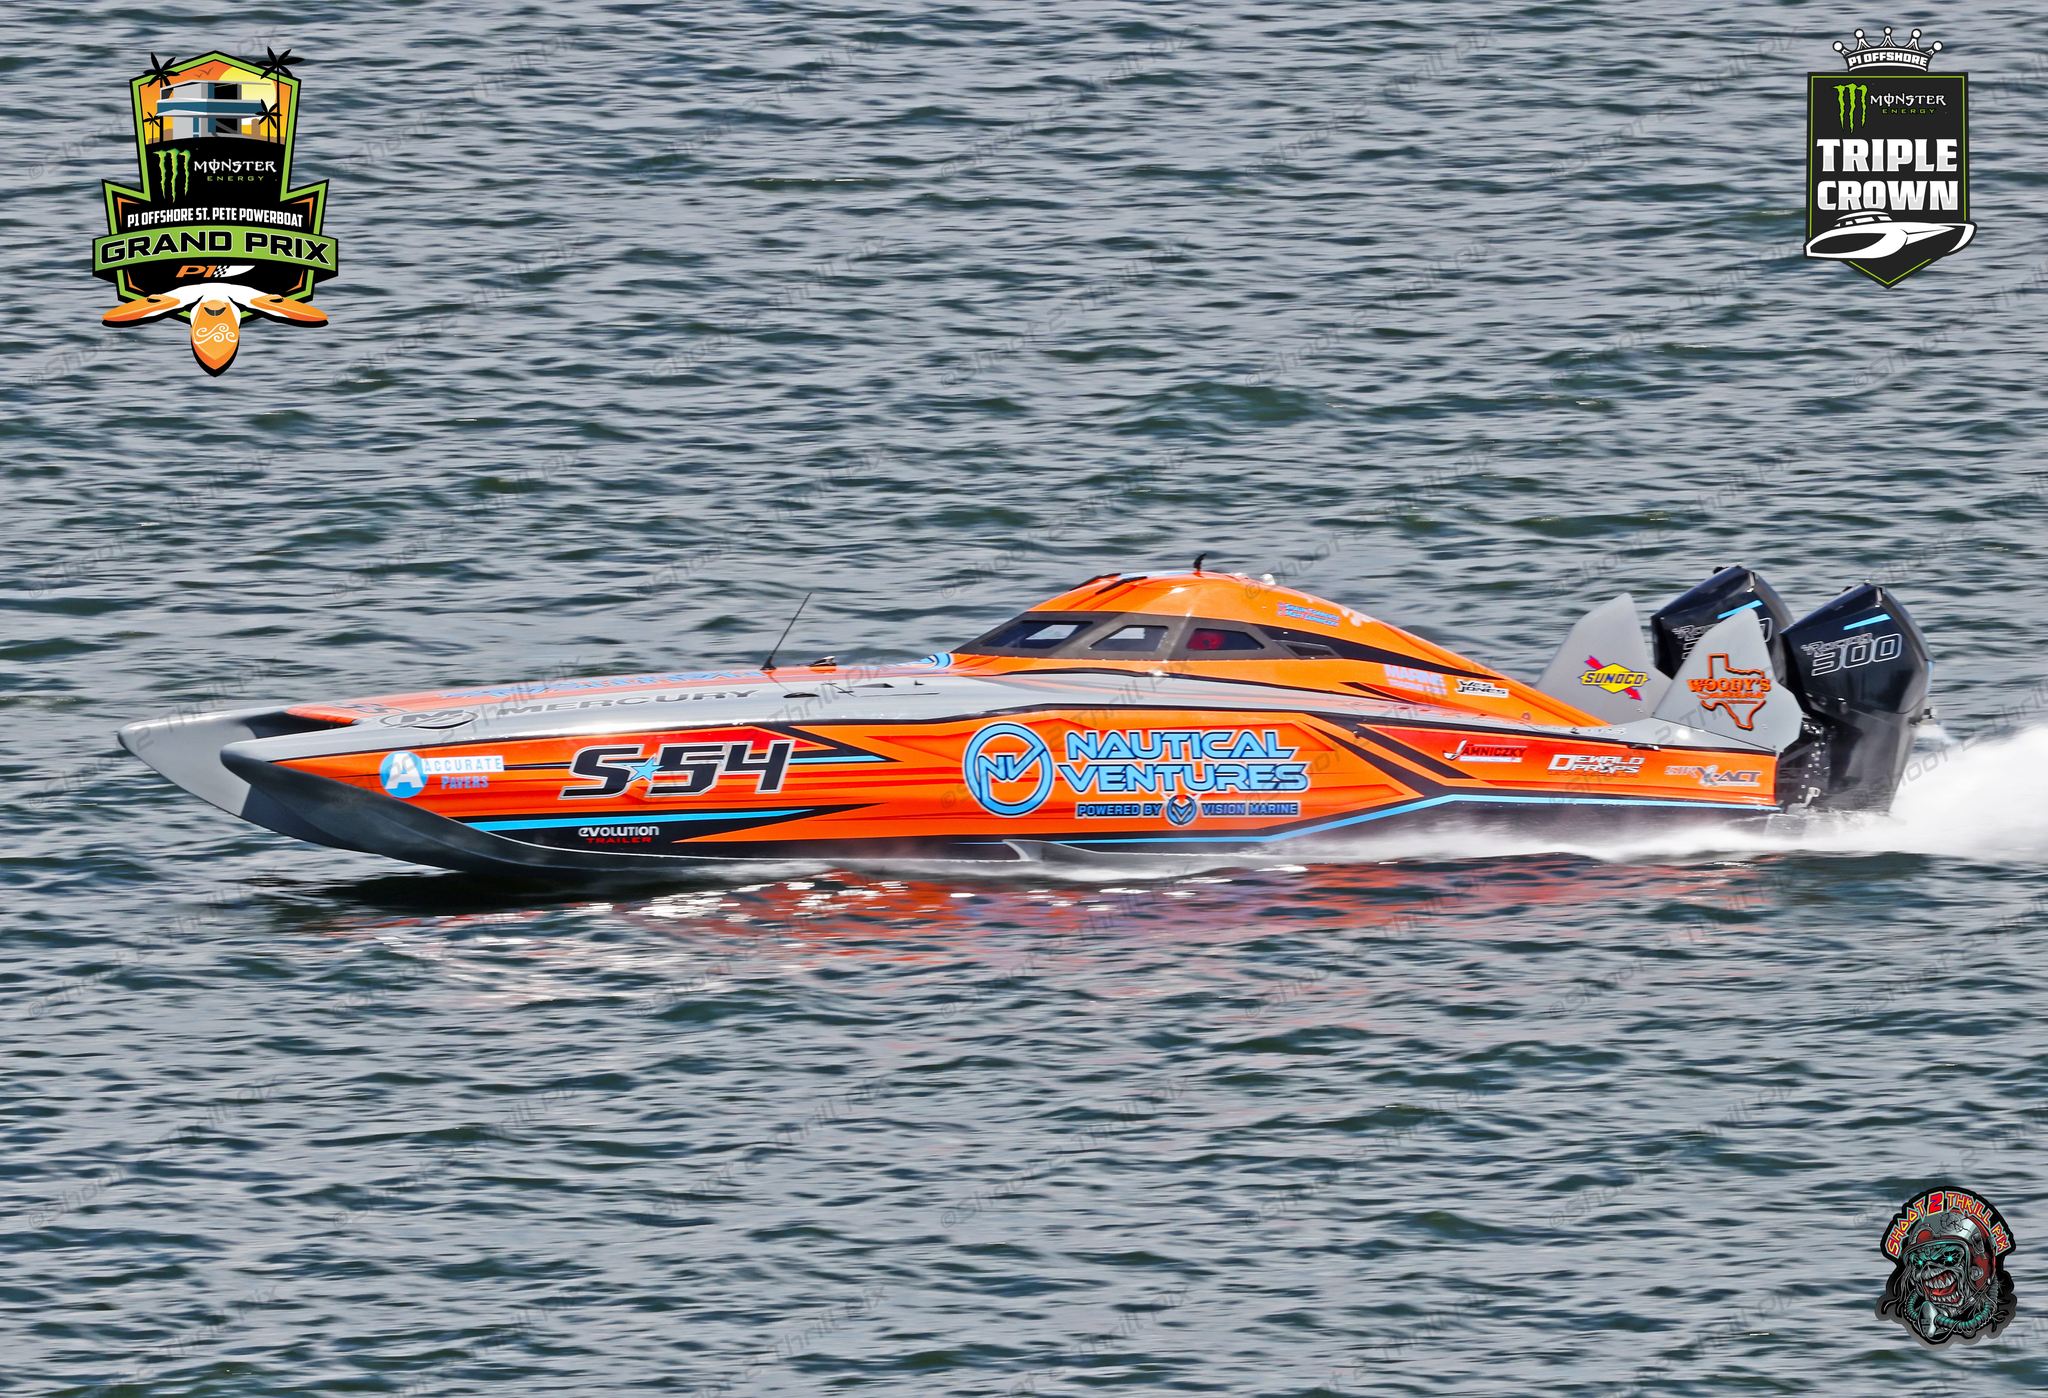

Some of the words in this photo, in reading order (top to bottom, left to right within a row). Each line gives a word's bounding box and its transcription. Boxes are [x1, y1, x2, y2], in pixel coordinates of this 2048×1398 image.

[1811, 633, 1902, 677] 300
[1584, 672, 1646, 685] SUNOCO
[496, 690, 759, 716] MERCURY
[1065, 729, 1299, 761] NAUTICAL
[424, 757, 502, 772] ACCURATE
[1057, 761, 1312, 794] VENTURES
[1077, 803, 1141, 816] POWERED
[1143, 803, 1163, 816] BY
[1202, 802, 1246, 815] VISION
[1249, 802, 1298, 815] MARINE
